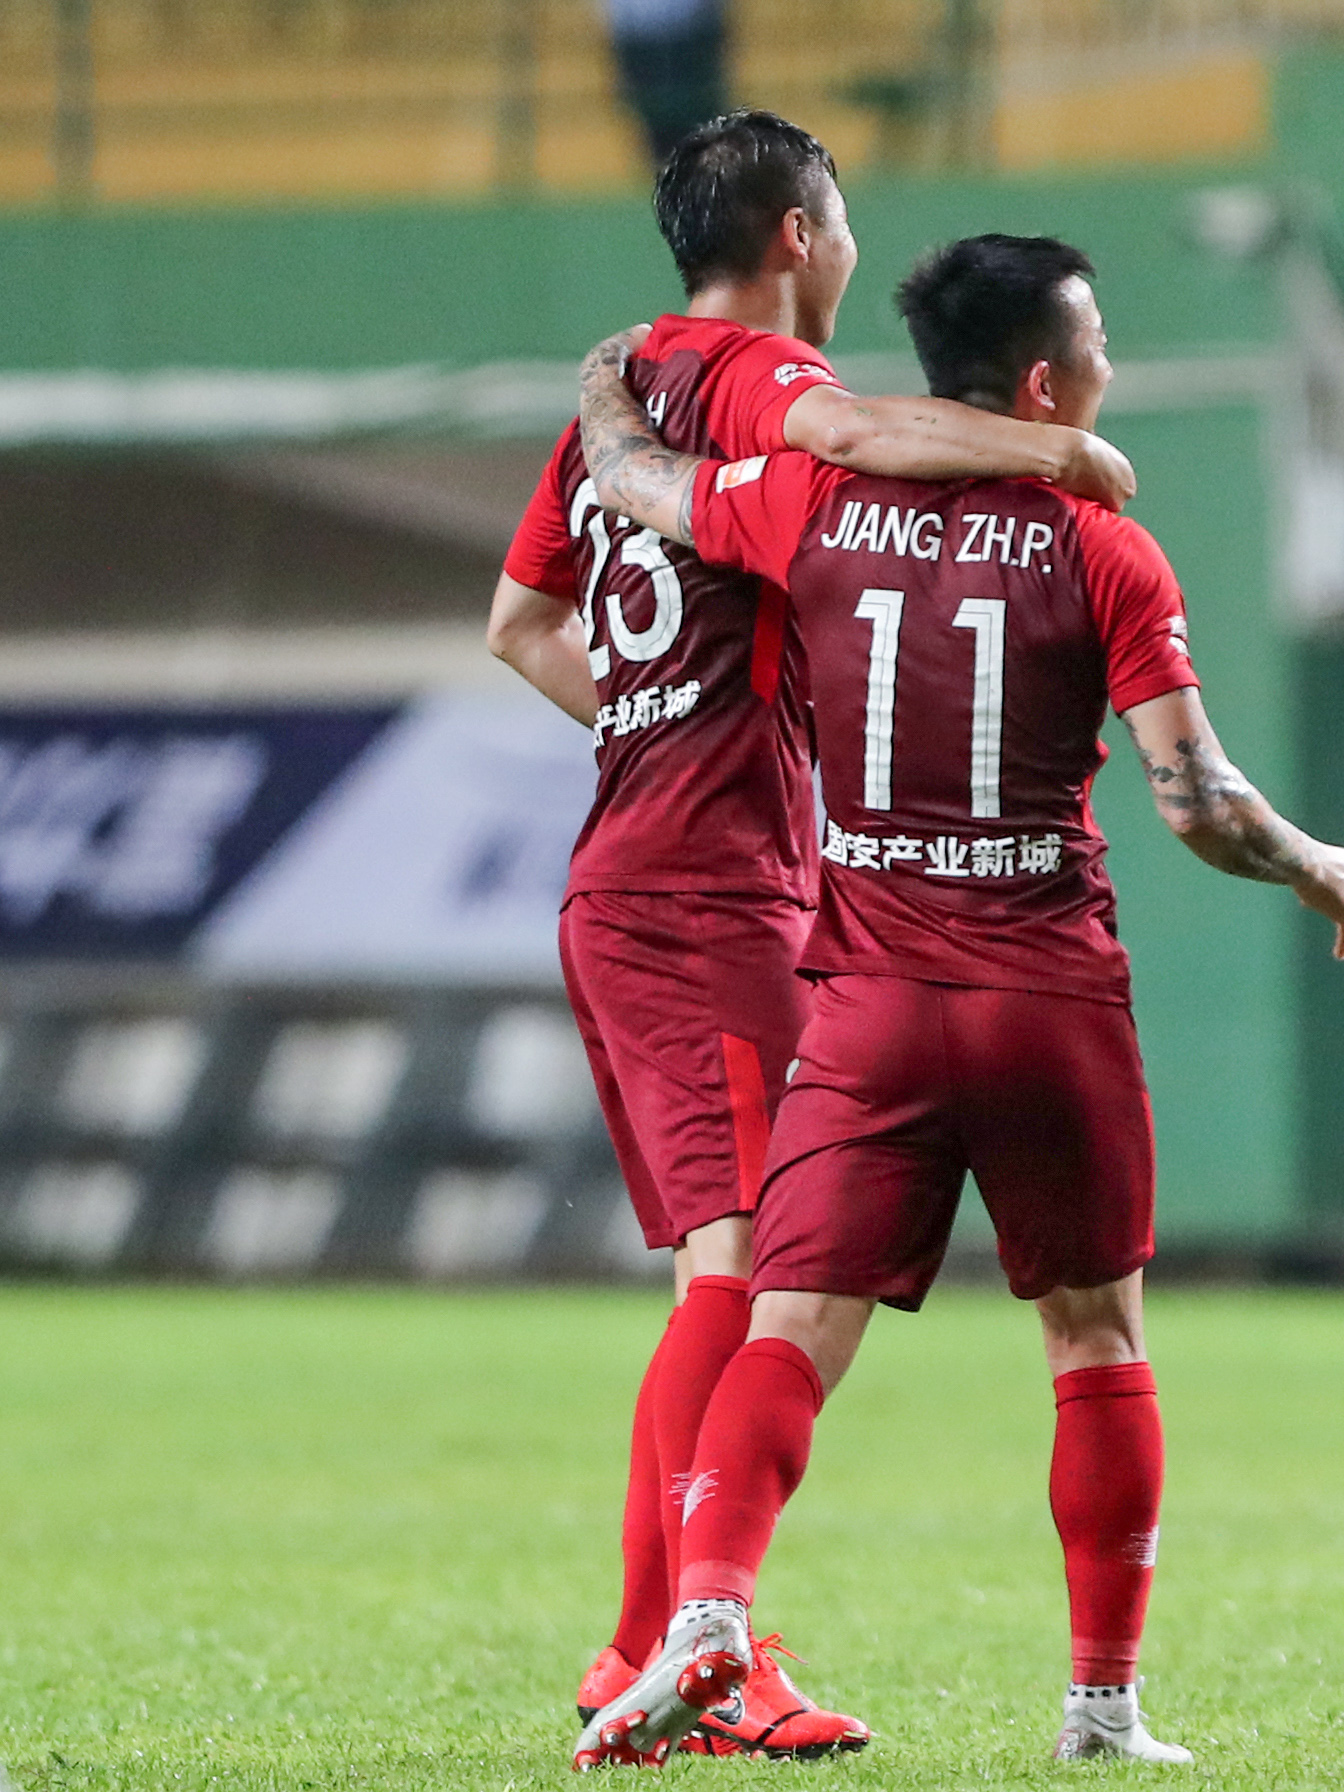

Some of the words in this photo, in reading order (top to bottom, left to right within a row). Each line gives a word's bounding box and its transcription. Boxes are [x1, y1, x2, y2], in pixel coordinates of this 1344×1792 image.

[820, 500, 945, 562] JIANG
[954, 512, 1055, 574] ZH.P.
[569, 477, 685, 682] 23
[821, 818, 1065, 878] 固安产业新城
